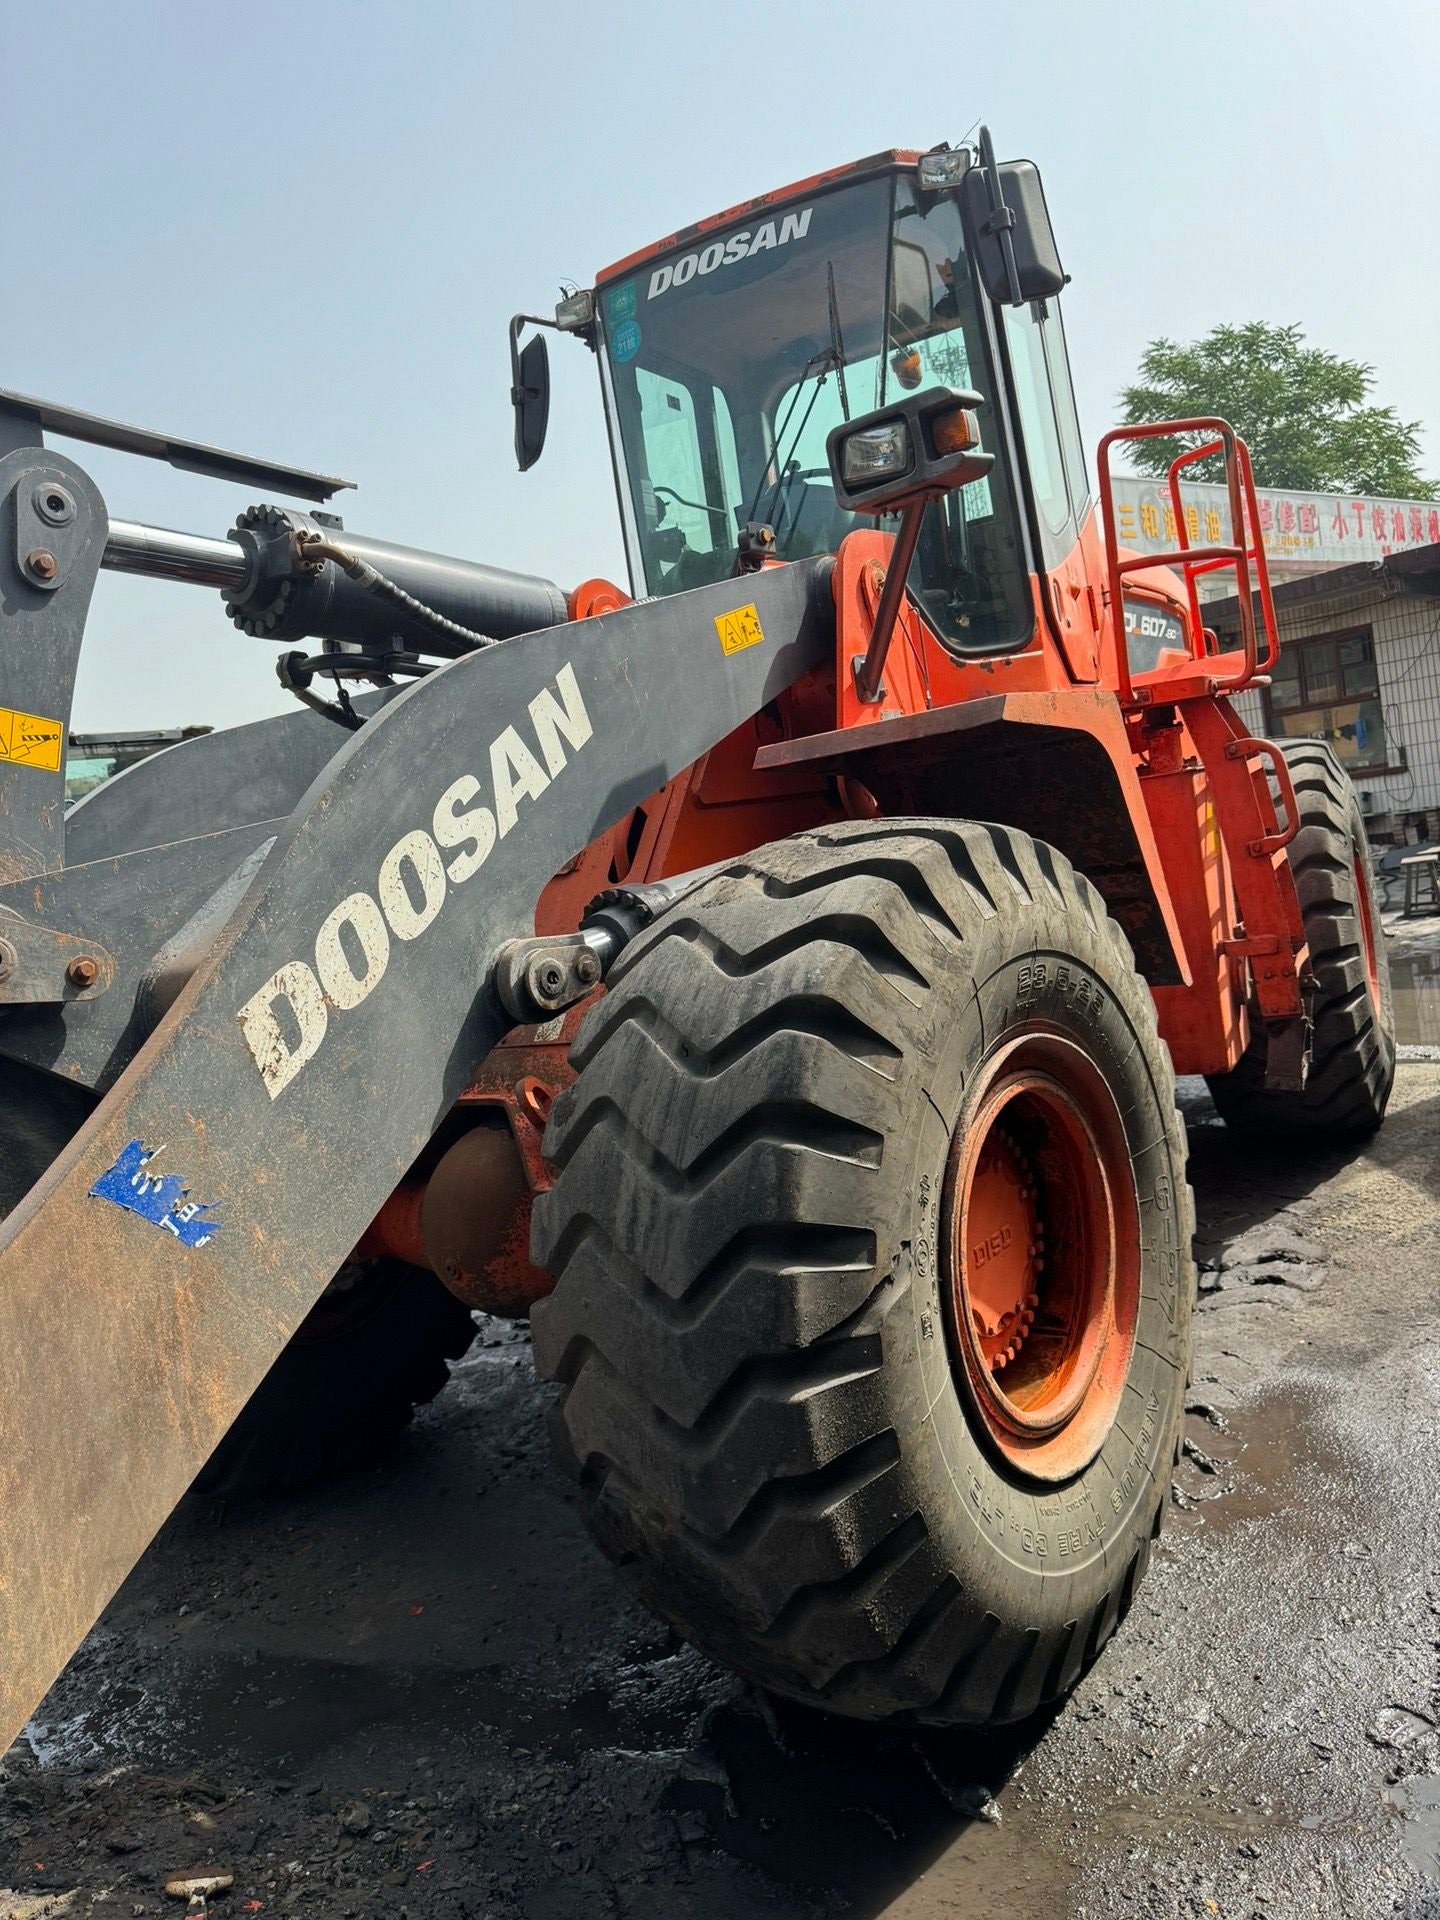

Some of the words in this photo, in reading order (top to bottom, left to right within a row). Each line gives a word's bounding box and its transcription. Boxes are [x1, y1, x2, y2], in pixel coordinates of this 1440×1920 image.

[647, 208, 813, 300] DOOSAN
[237, 662, 593, 1100] DOOSAN
[1110, 1390, 1160, 1514] AEOLUS
[1057, 1511, 1107, 1557] TYRE
